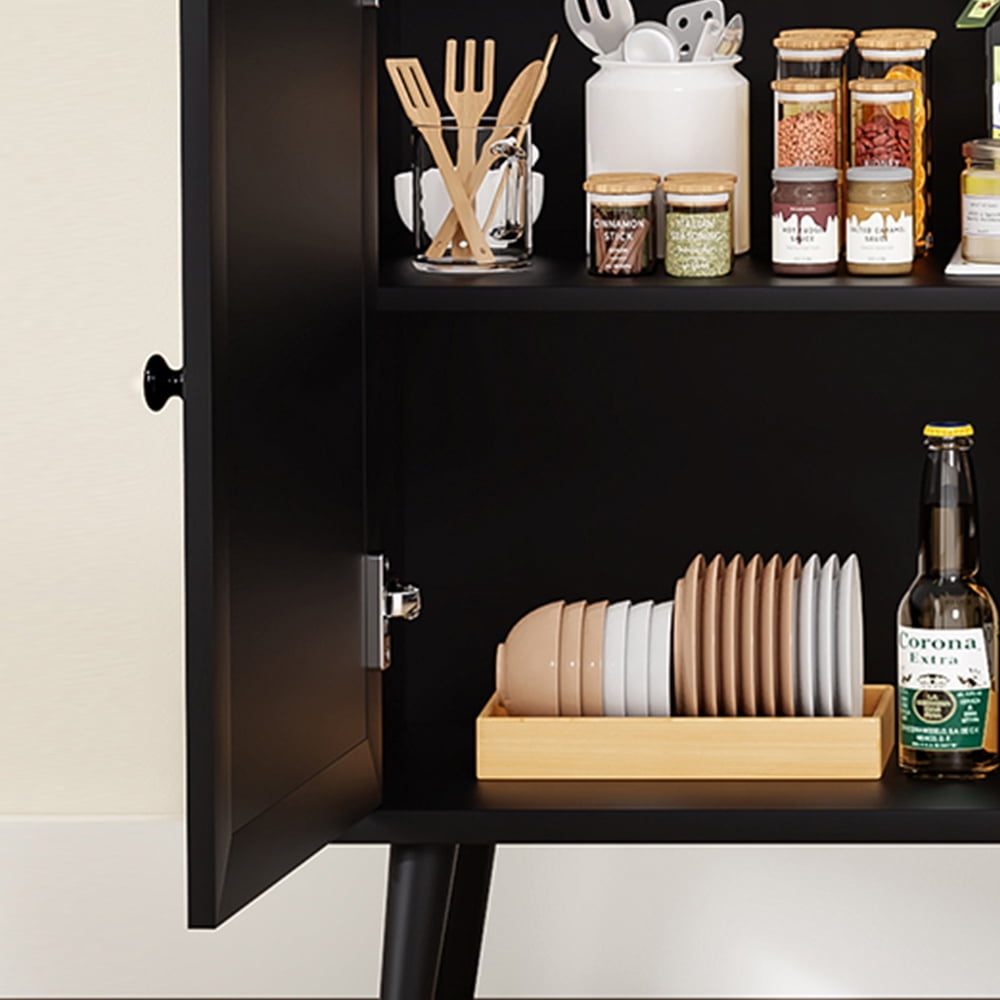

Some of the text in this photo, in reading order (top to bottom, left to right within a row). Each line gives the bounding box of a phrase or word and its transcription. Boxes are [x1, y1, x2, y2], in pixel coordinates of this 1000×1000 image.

[592, 218, 645, 229] CINNAMON
[899, 630, 977, 650] Corona
[909, 651, 960, 665] Extra
